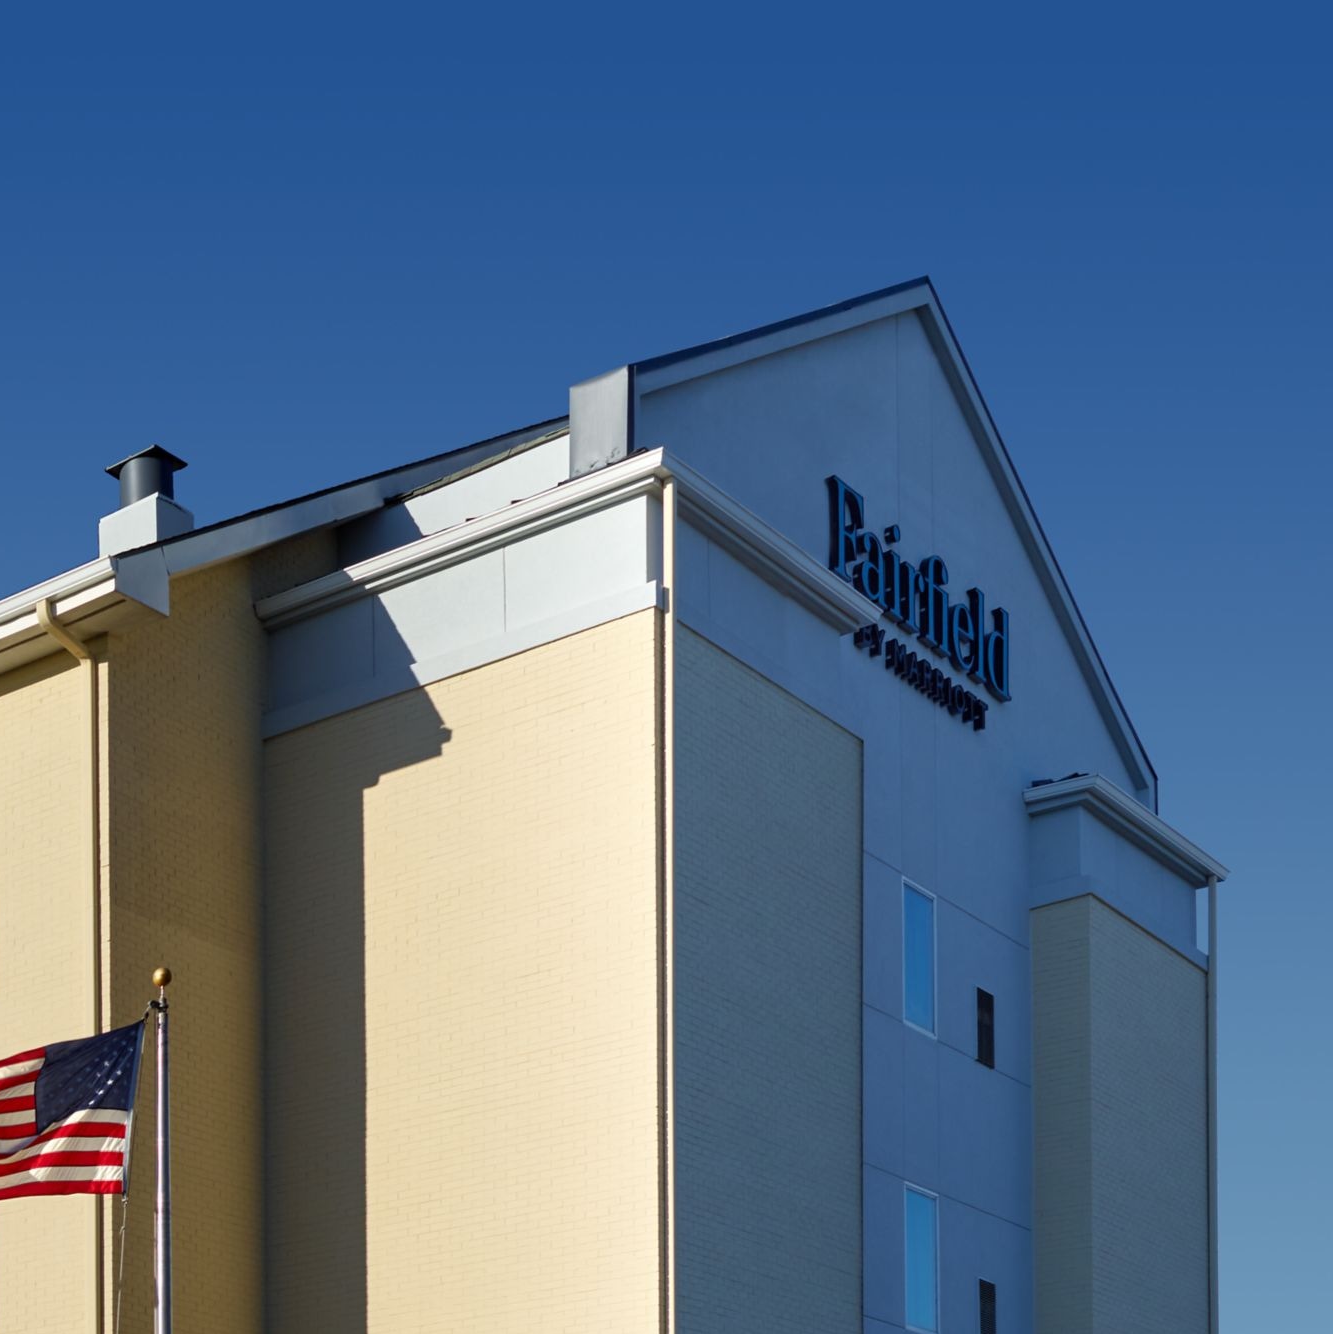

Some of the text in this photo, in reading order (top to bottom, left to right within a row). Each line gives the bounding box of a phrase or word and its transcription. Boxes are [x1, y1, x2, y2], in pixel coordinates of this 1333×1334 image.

[824, 474, 1012, 702] Fairfield
[853, 623, 988, 731] BY MARRIOTT
